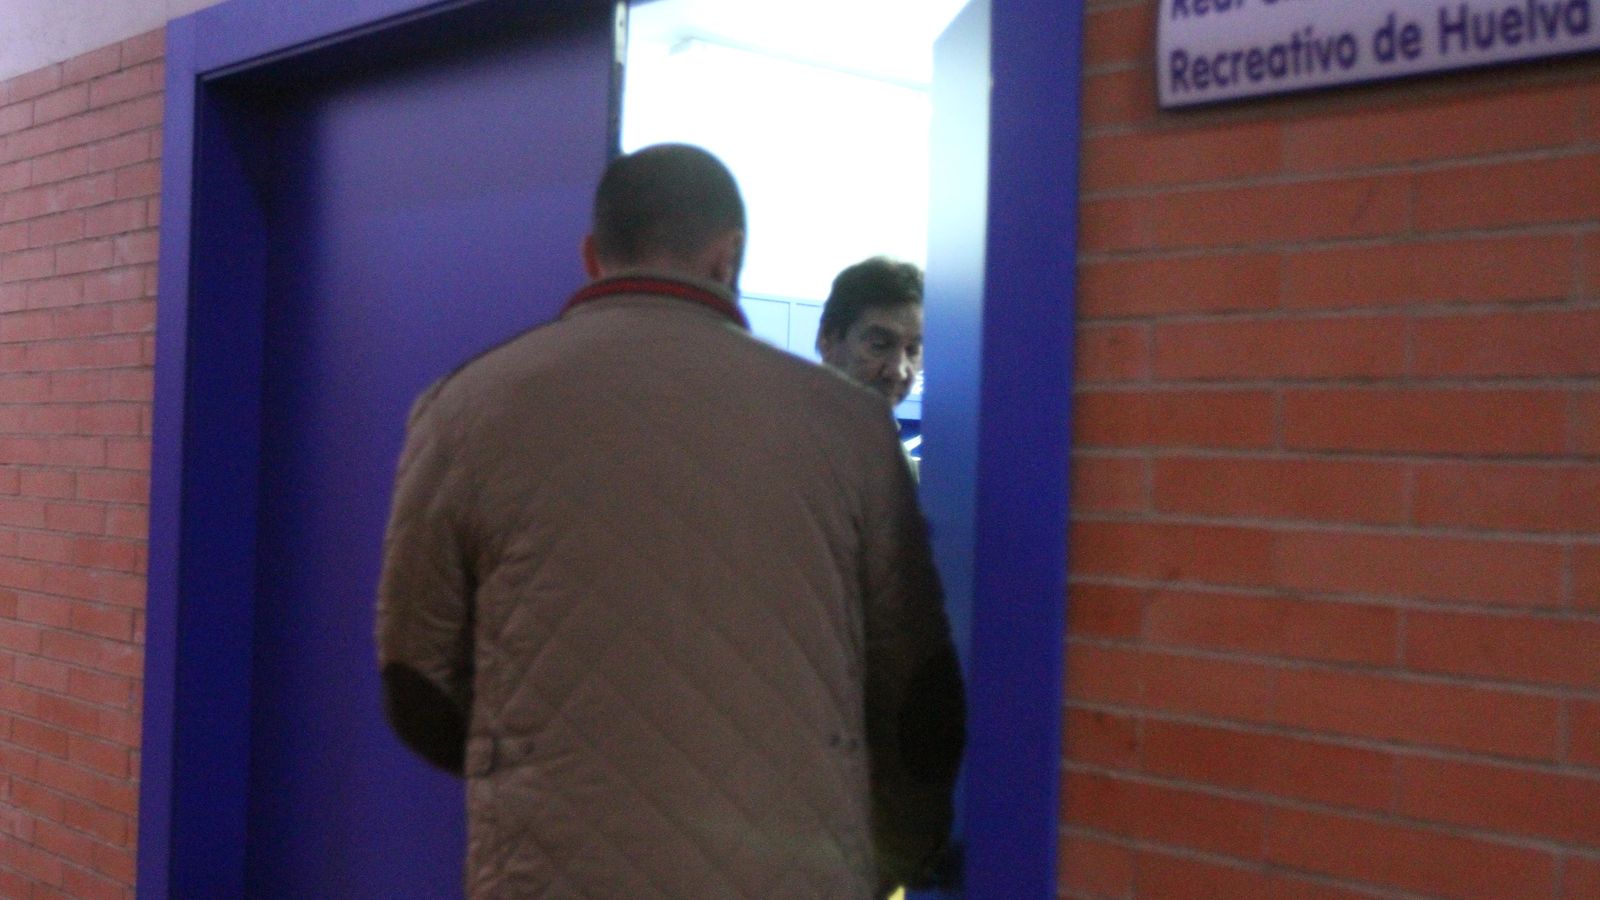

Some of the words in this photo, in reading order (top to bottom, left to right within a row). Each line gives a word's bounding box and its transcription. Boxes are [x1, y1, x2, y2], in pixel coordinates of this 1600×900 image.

[1169, 26, 1357, 94] Recreativo
[1373, 12, 1422, 62] de
[1438, 0, 1590, 54] Huelva
